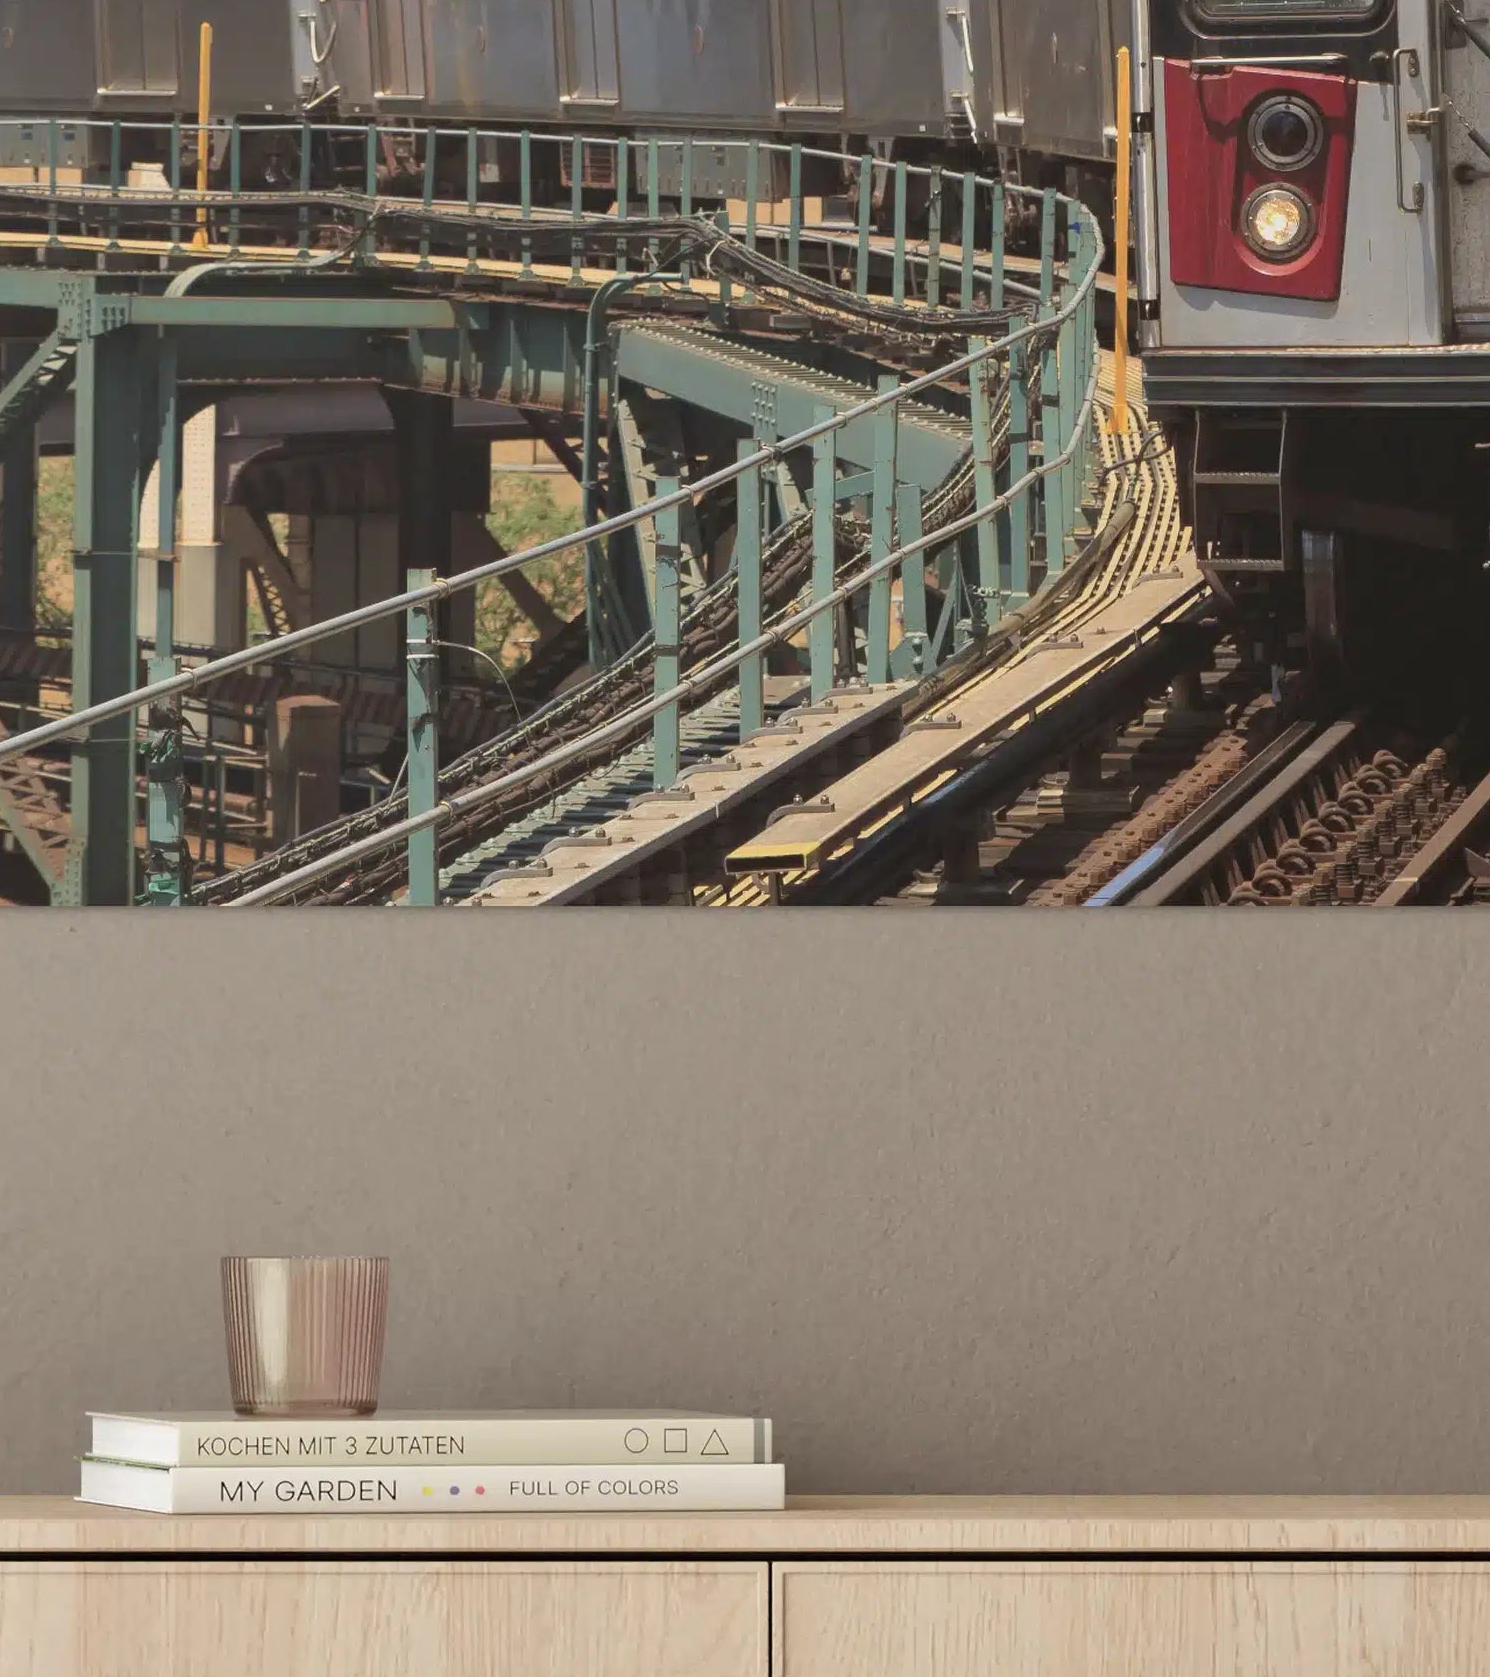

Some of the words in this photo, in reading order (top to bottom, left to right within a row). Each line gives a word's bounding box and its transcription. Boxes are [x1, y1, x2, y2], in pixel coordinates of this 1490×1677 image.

[197, 1436, 291, 1456] KOCHEN
[298, 1436, 337, 1456] MIT
[345, 1436, 358, 1456] 3
[365, 1435, 465, 1456] ZUTATEN
[219, 1480, 265, 1503] MY
[274, 1479, 398, 1502] GARDEN
[509, 1480, 558, 1496] FULL
[565, 1480, 591, 1496] OF
[597, 1479, 680, 1496] COLORS
